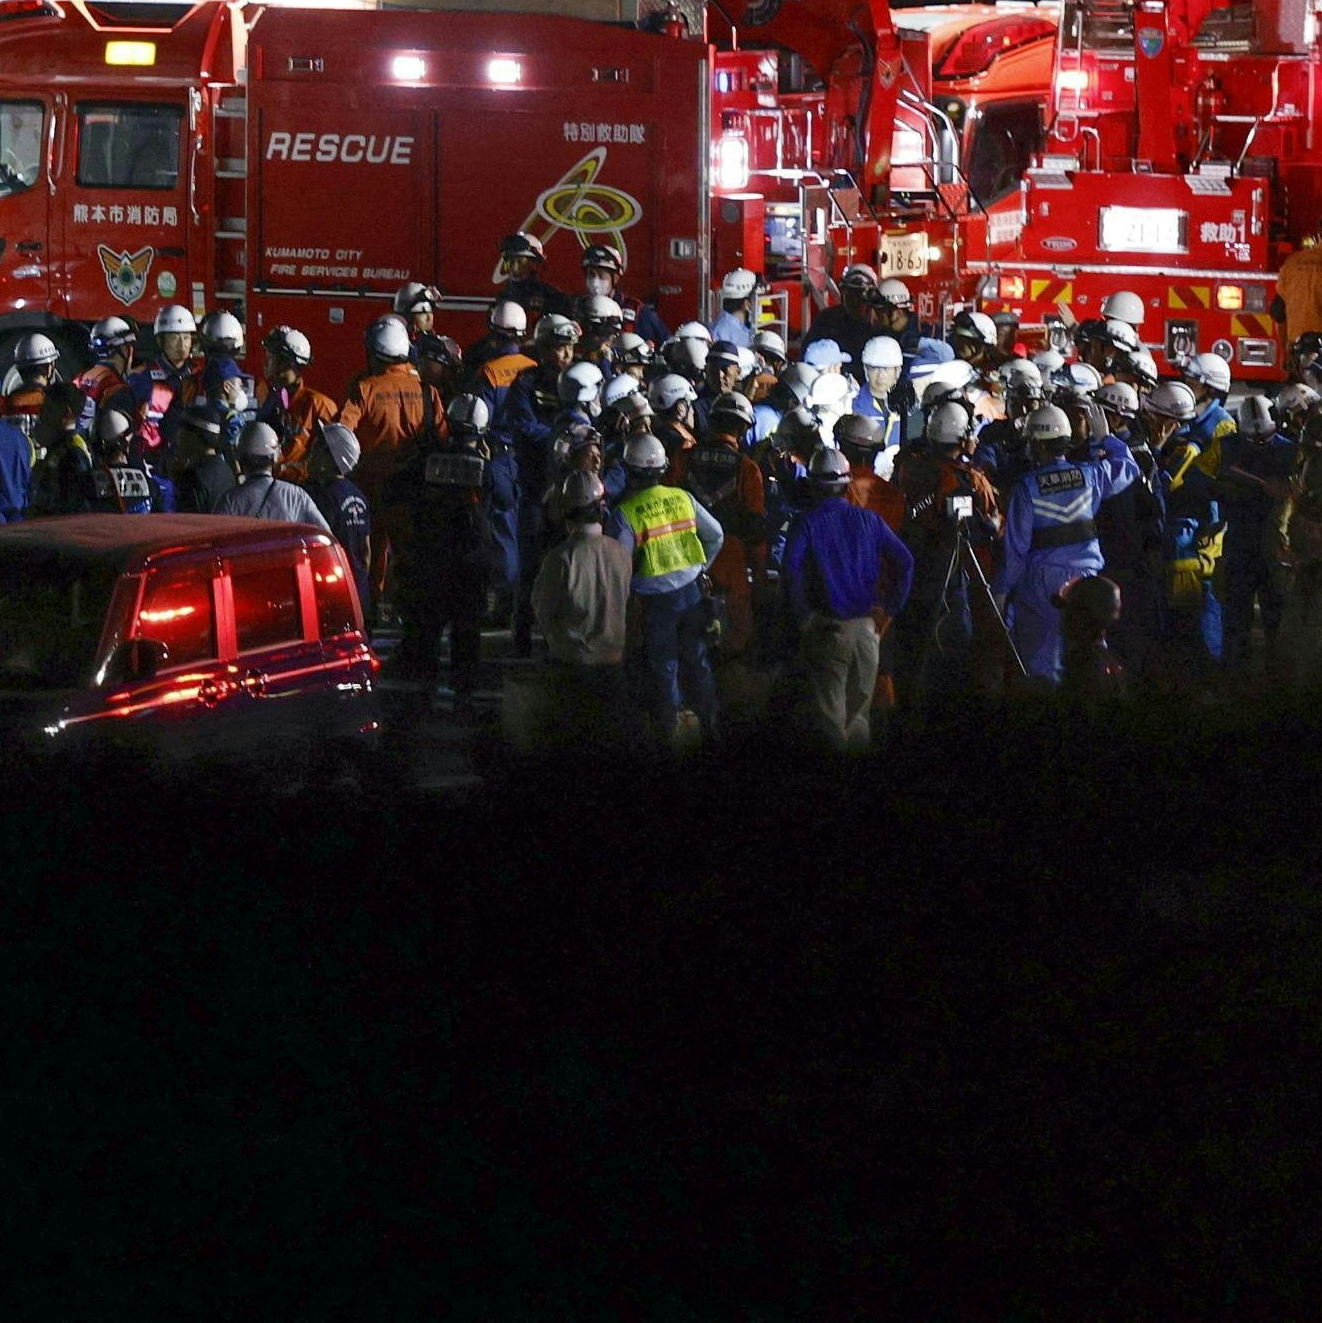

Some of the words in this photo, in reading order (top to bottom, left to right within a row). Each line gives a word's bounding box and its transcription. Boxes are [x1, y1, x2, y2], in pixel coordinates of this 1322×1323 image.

[563, 122, 646, 144] 特別救助隊
[265, 131, 415, 165] RESCUE
[73, 203, 178, 226] 熊本市消防局
[265, 246, 330, 260] KUMAMOTO
[336, 249, 364, 262] CITY
[270, 263, 297, 276] FIRE
[301, 264, 358, 278] SERVICES
[362, 266, 410, 280] BUREAU
